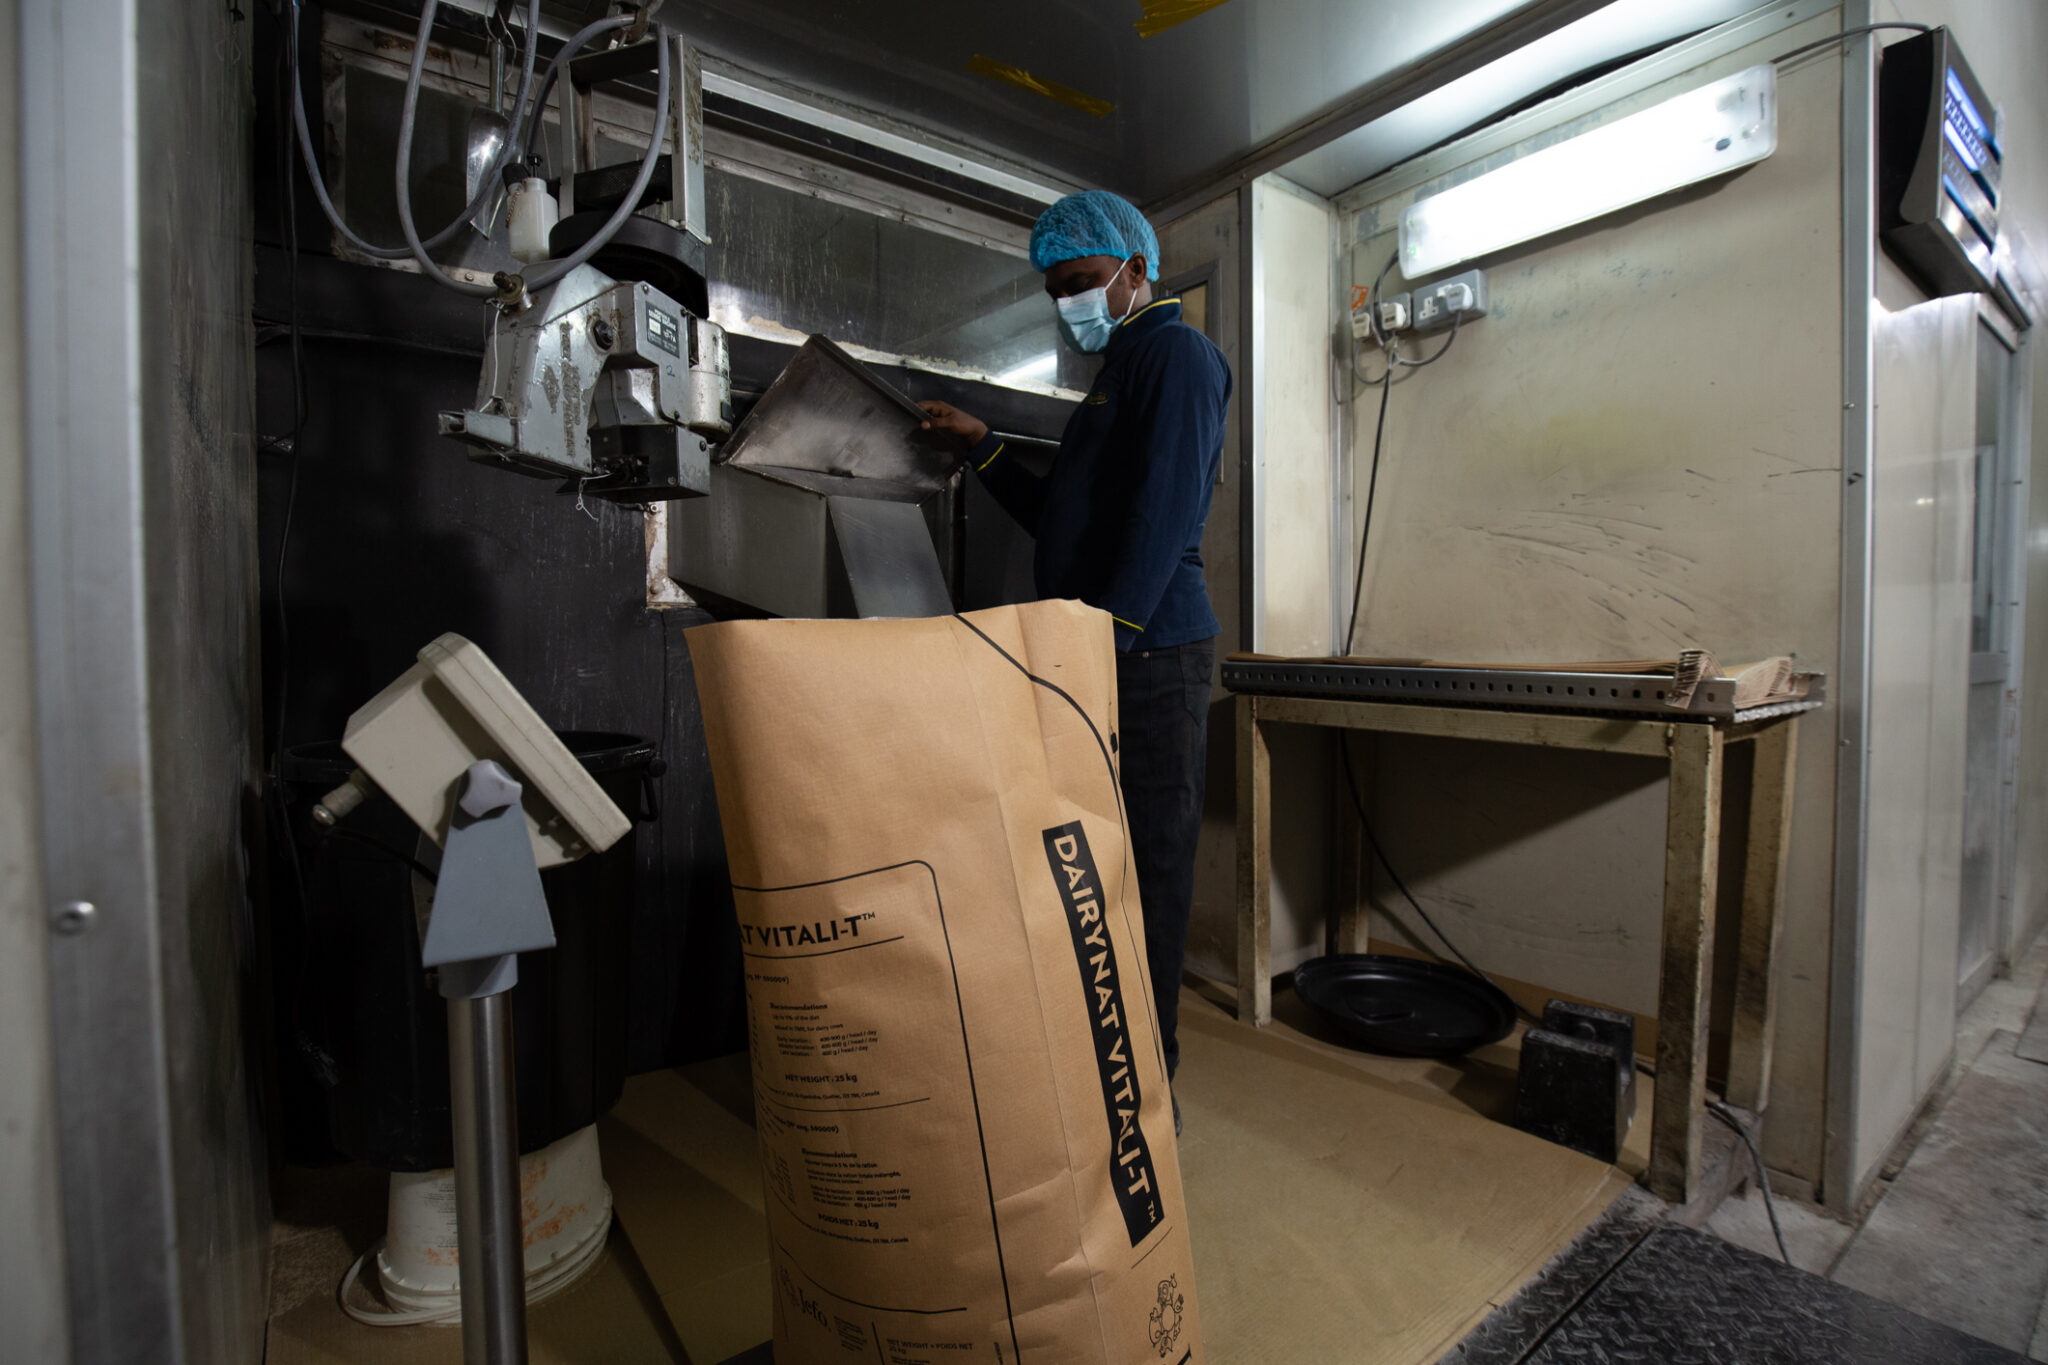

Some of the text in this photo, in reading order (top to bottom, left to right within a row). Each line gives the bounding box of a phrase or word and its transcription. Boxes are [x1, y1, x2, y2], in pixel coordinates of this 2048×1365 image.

[1053, 834, 1120, 1029] DAIRYNAT
[800, 1075, 830, 1083] WEIGHT
[835, 1074, 844, 1082] 25
[846, 1072, 858, 1083] kg
[868, 1219, 879, 1230] kg
